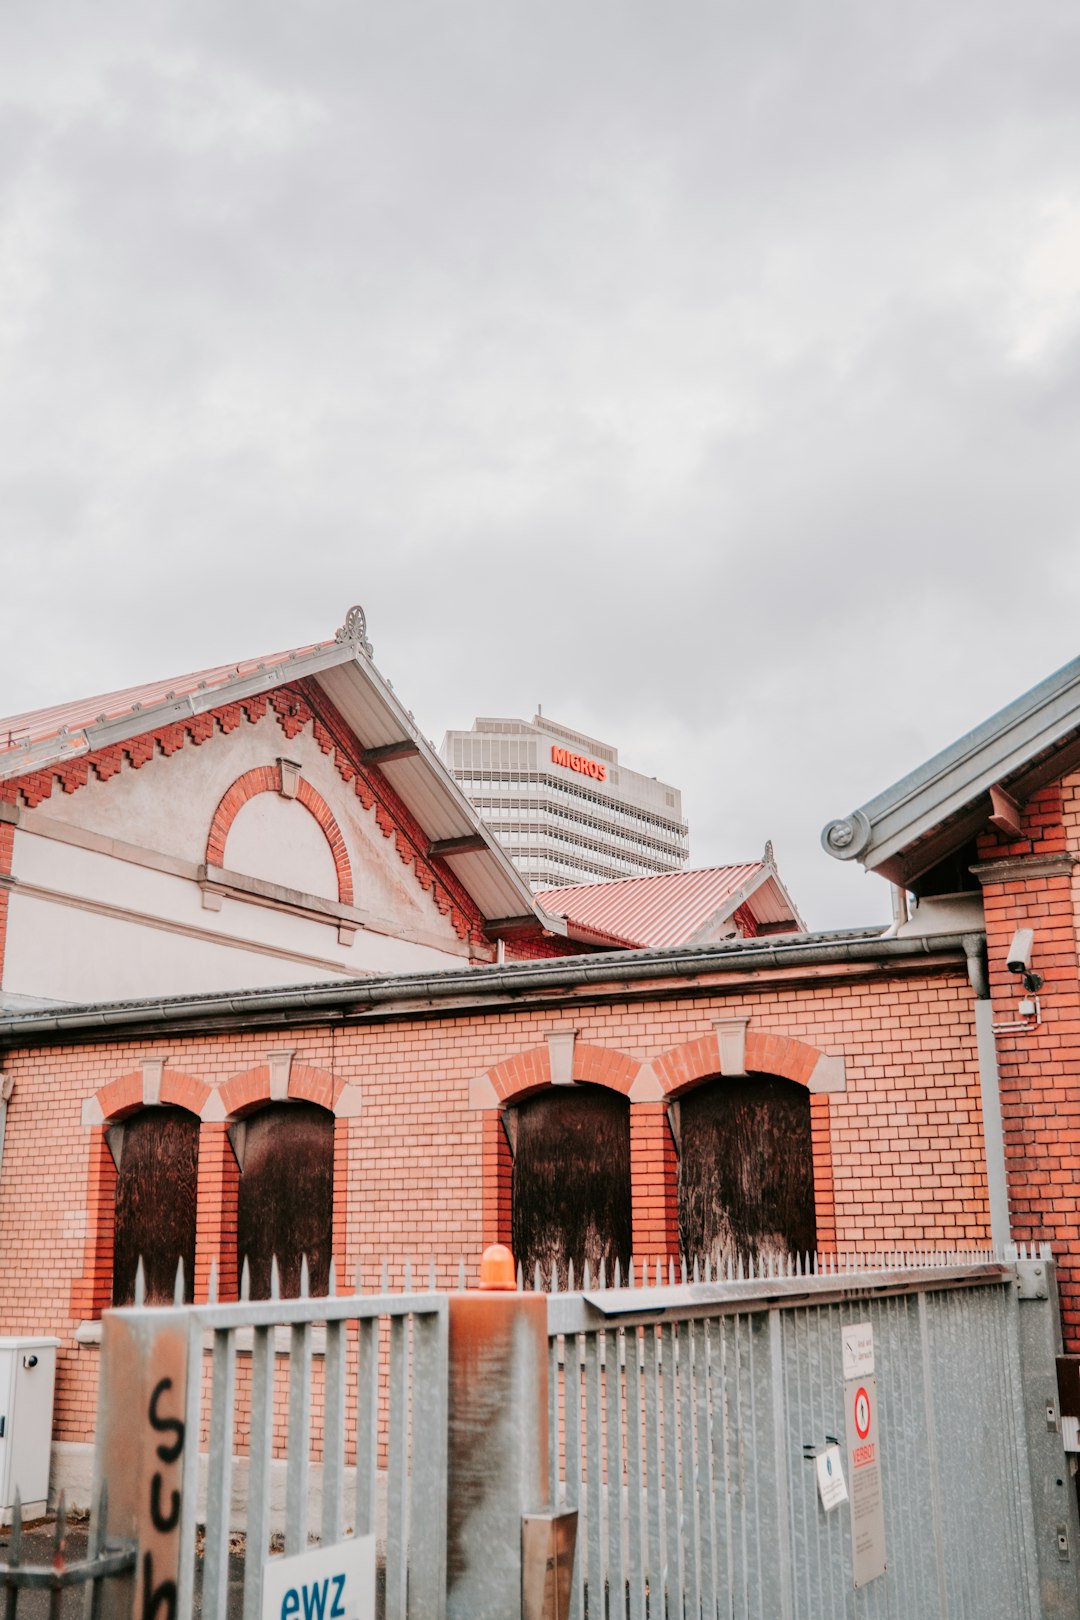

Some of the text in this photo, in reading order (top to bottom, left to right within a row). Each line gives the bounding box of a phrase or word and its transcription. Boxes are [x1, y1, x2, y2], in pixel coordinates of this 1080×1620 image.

[551, 745, 607, 782] MIGROS
[852, 1442, 875, 1463] VERBOT
[280, 1573, 346, 1620] ewz
